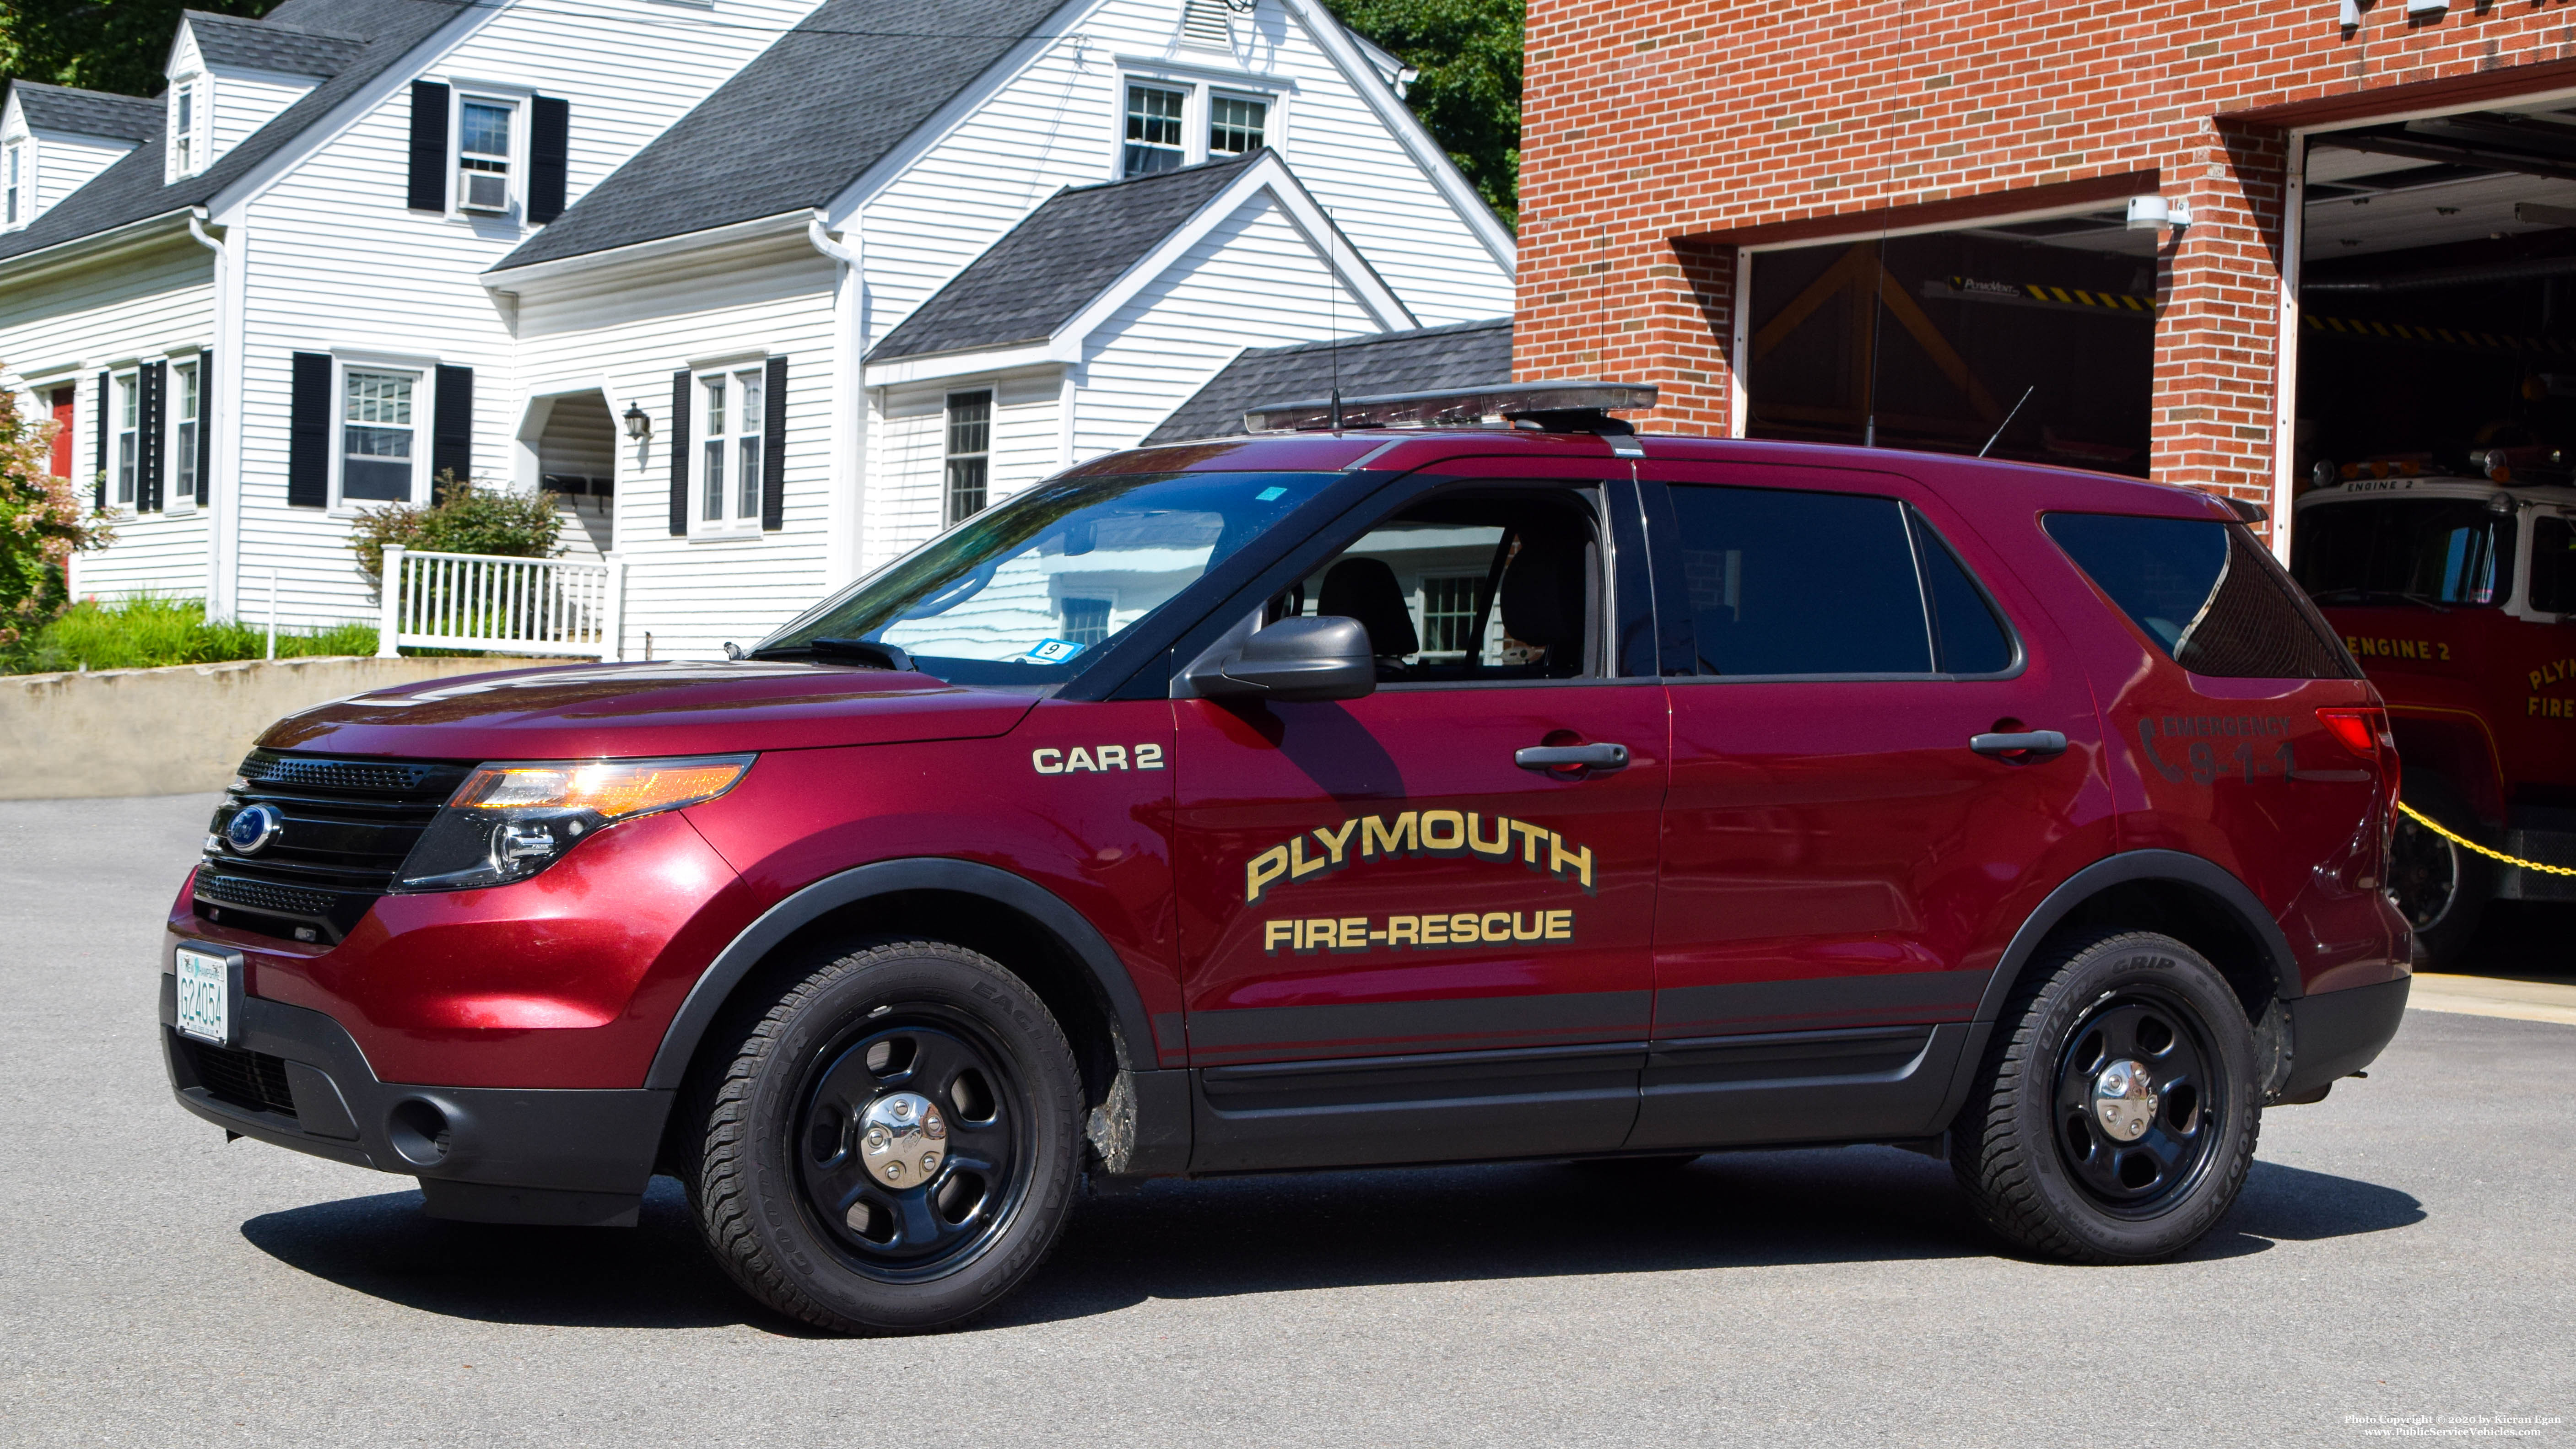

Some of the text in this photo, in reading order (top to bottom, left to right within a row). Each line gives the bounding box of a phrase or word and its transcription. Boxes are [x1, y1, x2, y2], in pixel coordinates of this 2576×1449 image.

[2347, 481, 2397, 492] ENGINE
[1044, 644, 1060, 655] 9
[2346, 636, 2450, 661] ENGINE 2
[2528, 696, 2574, 718] FIRE
[2163, 716, 2290, 737] EMERGENCY
[1032, 743, 1164, 774] CAR 2
[2189, 741, 2296, 785] 9-1-1
[230, 811, 256, 840] Ford
[1247, 809, 1593, 904] PLYMOUTH
[1264, 909, 1573, 953] FIRE-RESCUE
[2111, 955, 2177, 979] GRIP
[181, 977, 221, 1029] G24054
[753, 1025, 815, 1278] GOODYEAR
[971, 980, 1072, 1298] EAGLE ULTRA GRIP
[2155, 1083, 2254, 1249] GOODYEAR
